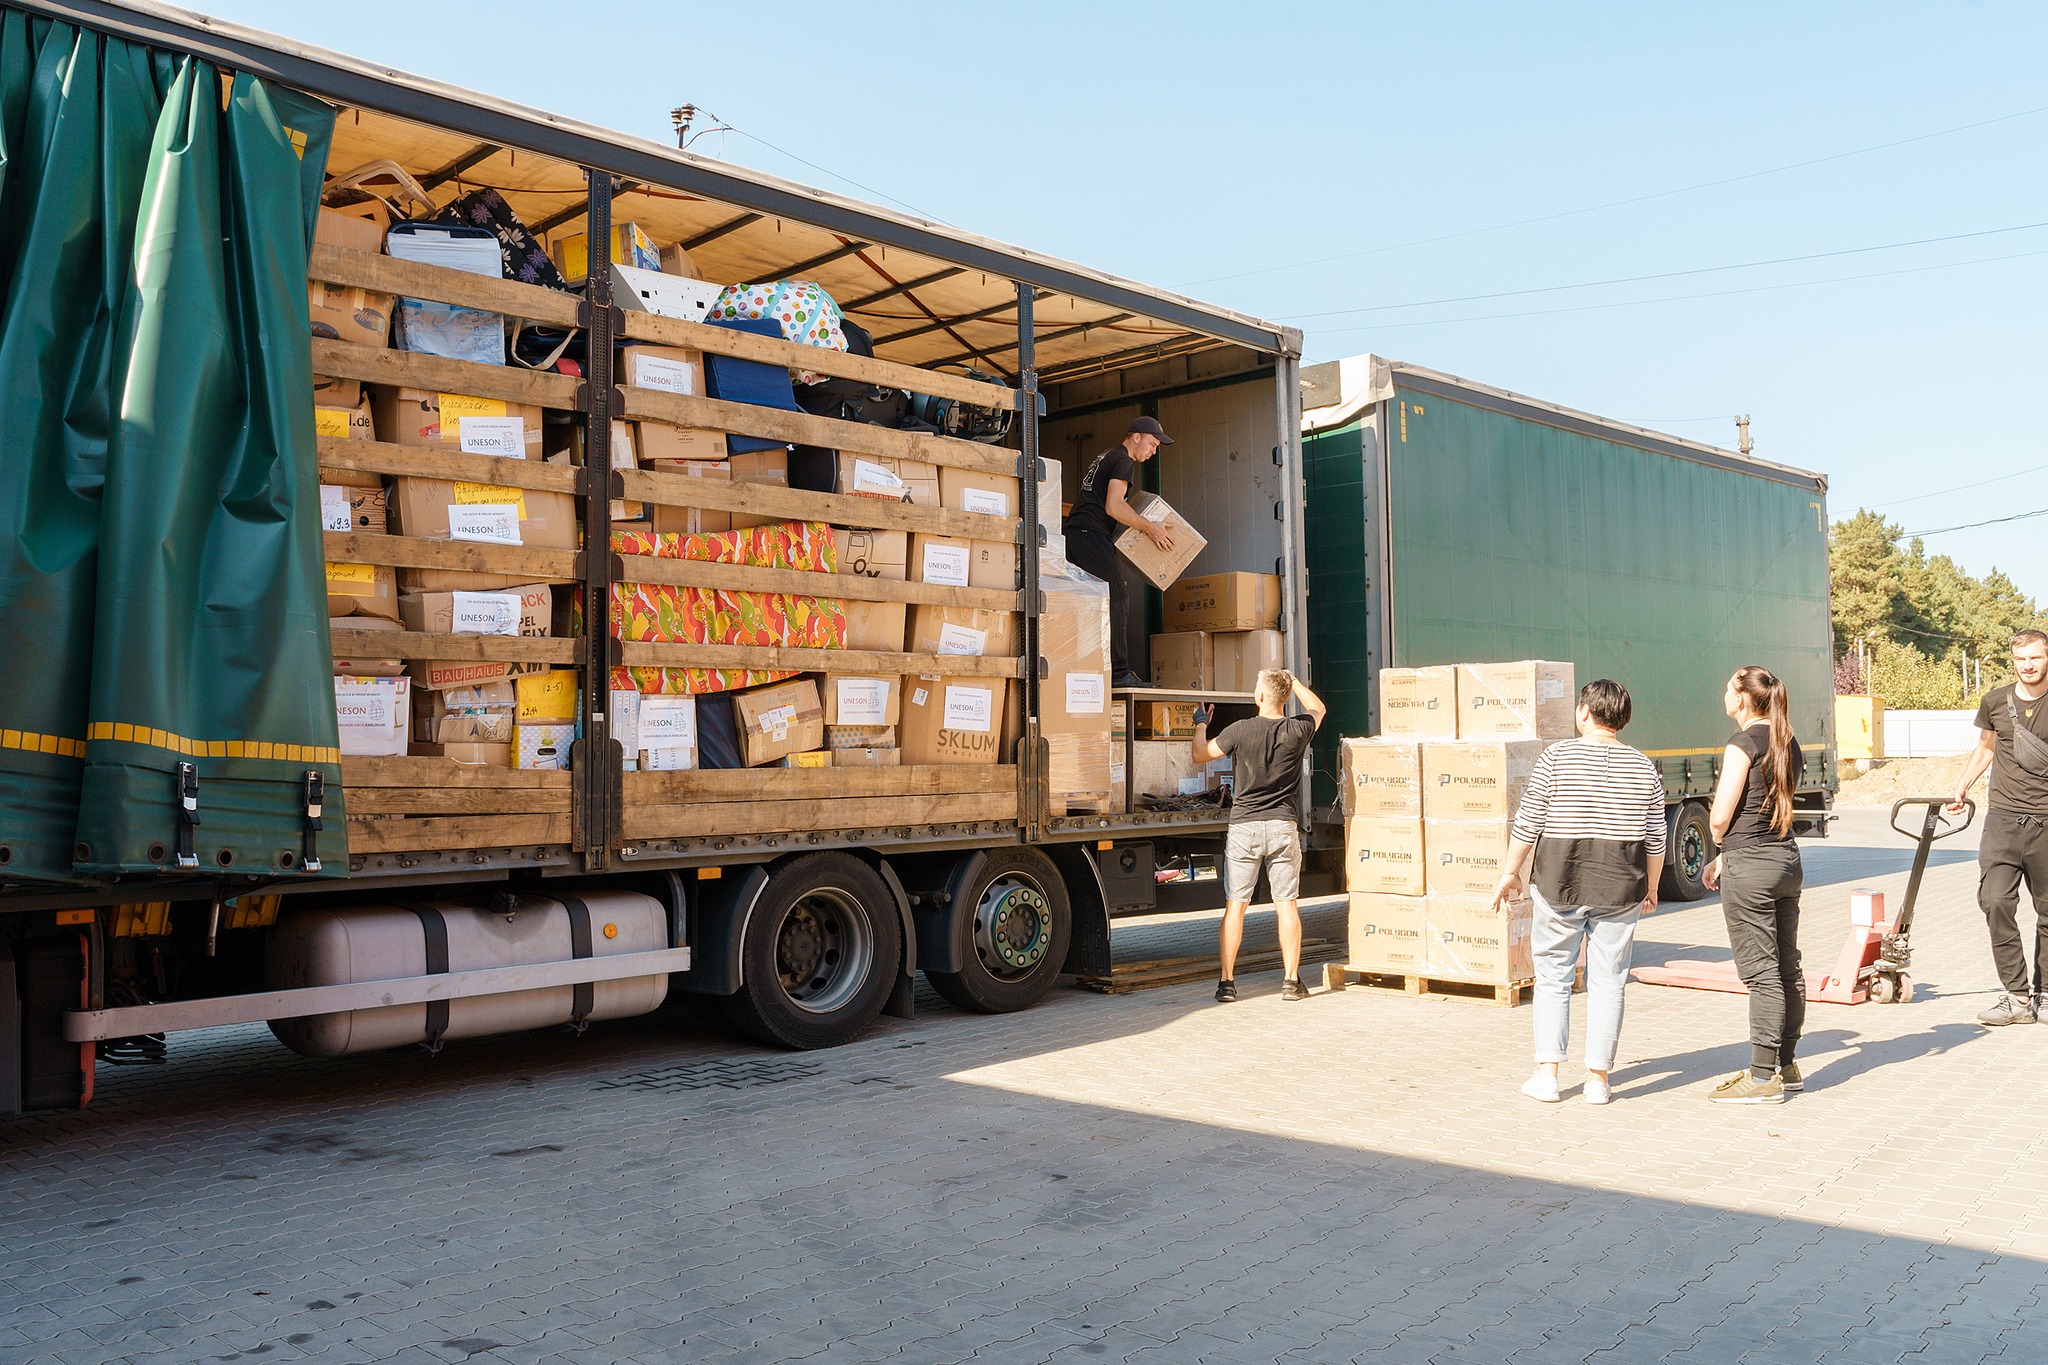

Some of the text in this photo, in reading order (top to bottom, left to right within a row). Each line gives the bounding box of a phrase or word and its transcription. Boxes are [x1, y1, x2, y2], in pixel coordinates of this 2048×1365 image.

[643, 374, 671, 386] UNESON
[316, 420, 340, 437] idung
[467, 438, 501, 446] UNESON
[860, 479, 884, 487] UNES
[970, 505, 991, 514] UNESON
[928, 561, 952, 571] UNESON
[1185, 583, 1210, 591] VOLKSWAGEN
[521, 593, 547, 608] ACK
[460, 613, 495, 622] UNESON
[519, 616, 536, 628] PEL
[945, 640, 968, 651] UNESON
[431, 663, 505, 684] BAUHAUS
[950, 703, 974, 711] UNESON
[1486, 698, 1527, 707] POLGON
[336, 706, 367, 715] NESON
[643, 719, 672, 727] UNESON
[937, 728, 996, 754] SKLUM
[1453, 776, 1496, 785] POLYGON
[1373, 851, 1412, 859] POLYGON
[1456, 856, 1498, 866] POLYGON
[1378, 928, 1419, 937] POLYGON
[1457, 935, 1499, 946] POLYGON
